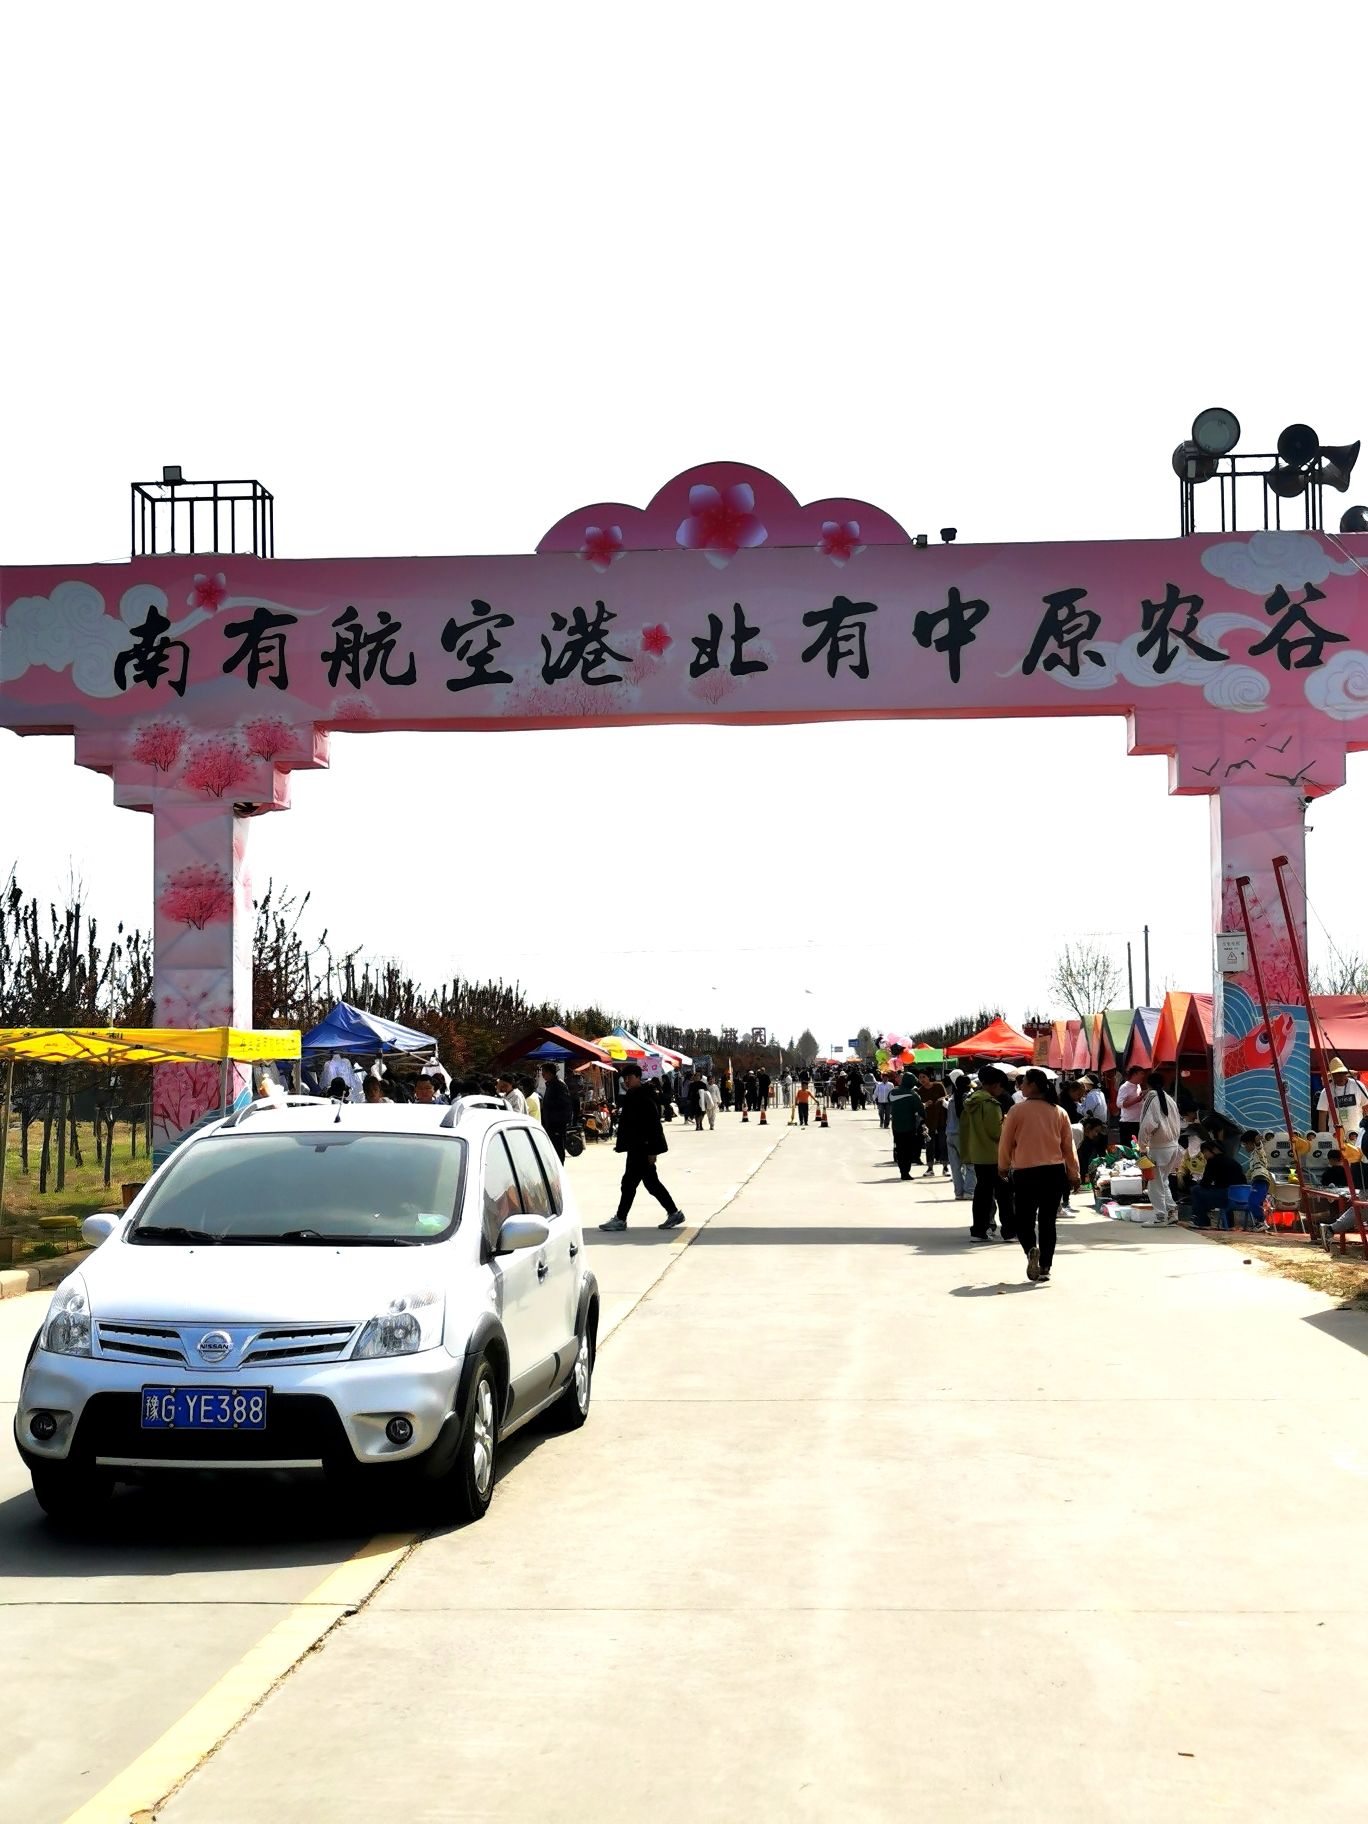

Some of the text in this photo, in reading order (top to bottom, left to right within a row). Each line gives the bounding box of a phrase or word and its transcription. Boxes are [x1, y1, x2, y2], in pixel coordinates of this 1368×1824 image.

[114, 582, 1349, 697] 南有航空港 北有中原农谷
[145, 1394, 263, 1423] 豫G·YE388
